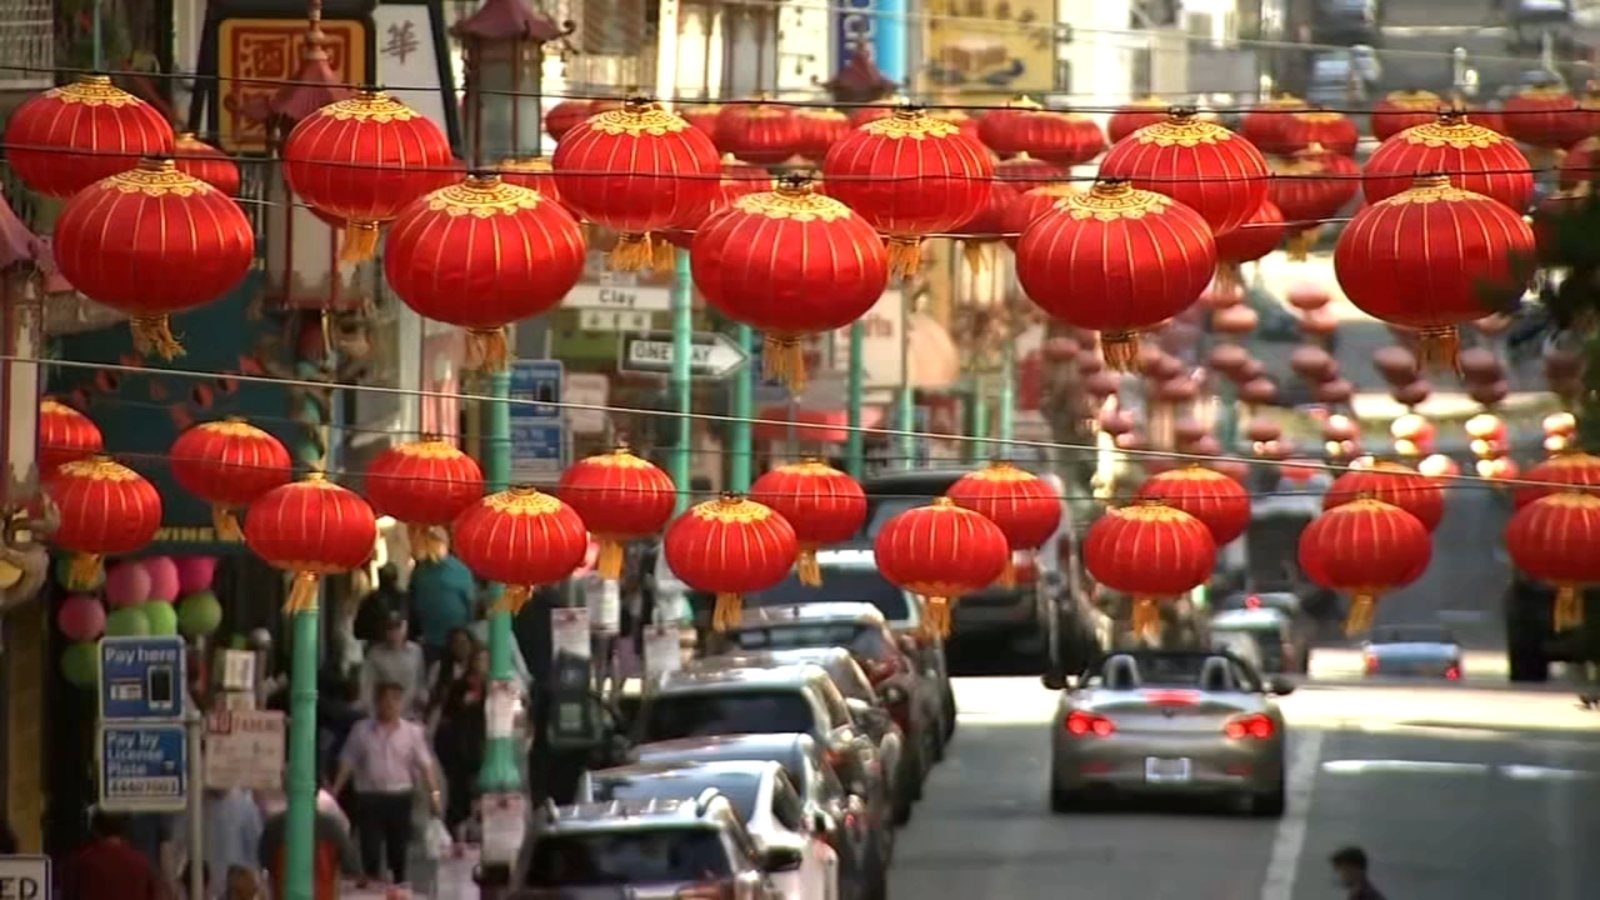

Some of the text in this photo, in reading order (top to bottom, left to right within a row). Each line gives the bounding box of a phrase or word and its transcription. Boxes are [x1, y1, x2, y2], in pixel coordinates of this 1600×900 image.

[599, 289, 636, 305] Clay
[635, 344, 670, 361] ONE
[105, 645, 177, 665] Pay here
[107, 730, 160, 750] Pay by
[107, 747, 164, 761] License
[107, 761, 147, 777] Plate
